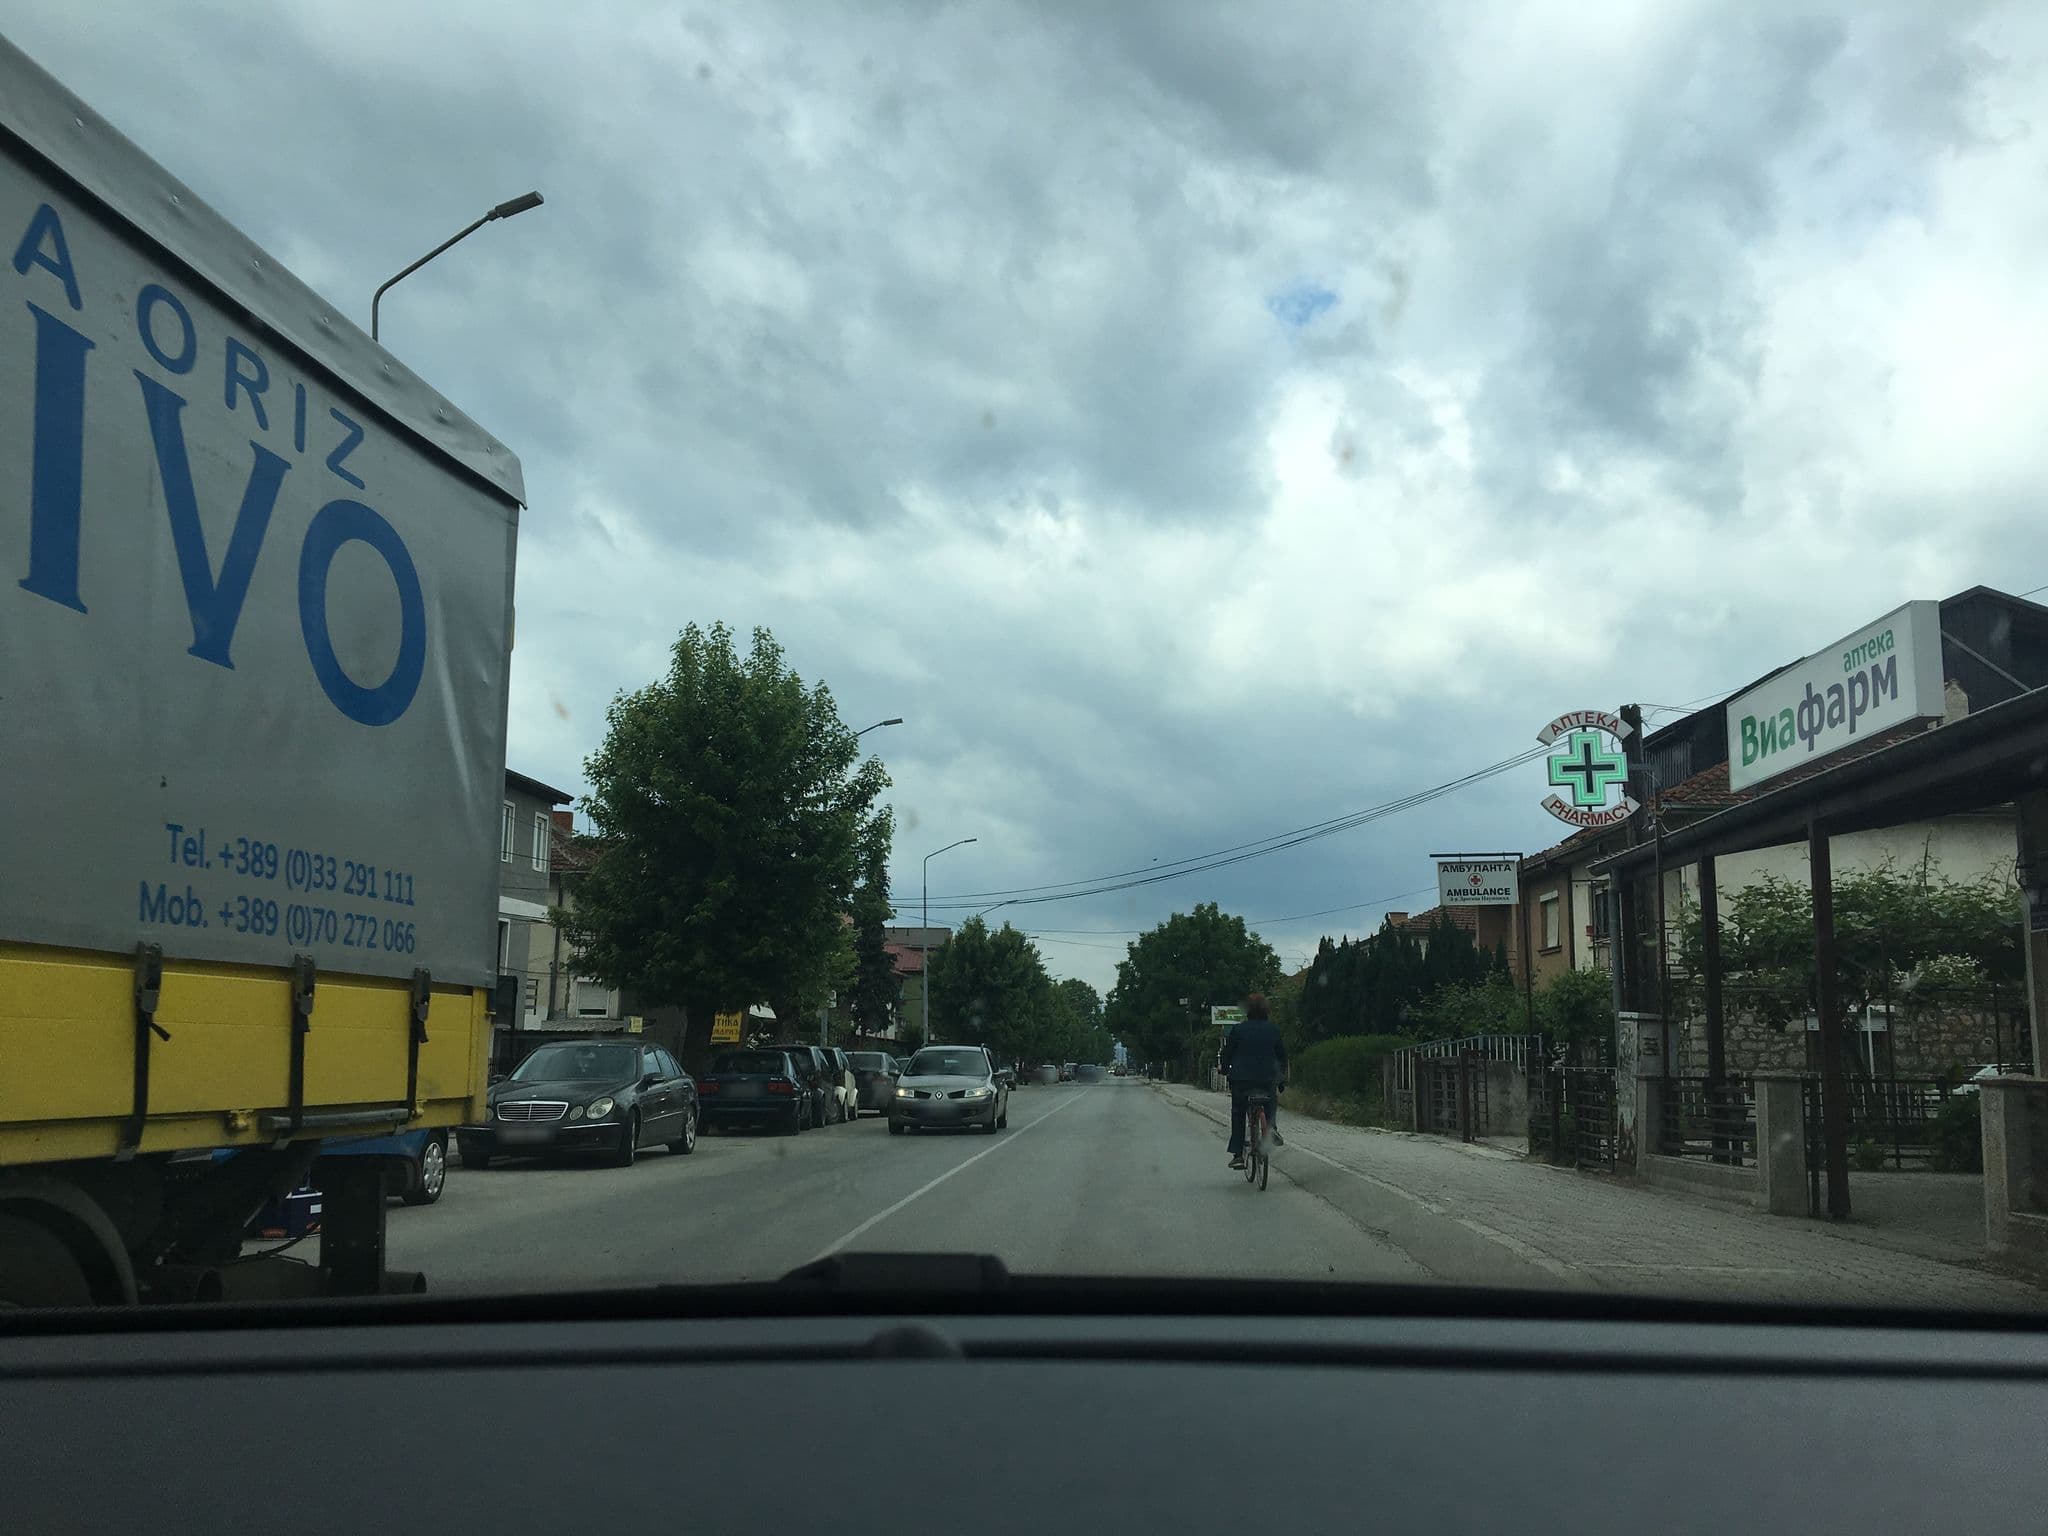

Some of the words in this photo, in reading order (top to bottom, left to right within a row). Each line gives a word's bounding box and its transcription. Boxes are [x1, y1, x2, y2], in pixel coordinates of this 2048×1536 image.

[18, 299, 427, 727] IVO
[1843, 628, 1895, 672] аптека
[1550, 711, 1620, 736] АПТЕКА
[1740, 654, 1899, 768] Виафарм
[1549, 799, 1632, 825] PHARMACY
[165, 823, 210, 869] Tel.
[218, 837, 279, 880] +389
[285, 848, 337, 892] (0)33
[343, 860, 378, 899] 291
[383, 870, 415, 906] 111
[1442, 864, 1512, 873] АМБУЛАНТА
[1446, 887, 1511, 896] AMBULANCE
[139, 880, 208, 928] Mob.
[218, 895, 279, 937] +389
[285, 903, 337, 947] (0)70
[343, 912, 378, 949] 272
[383, 919, 416, 954] 066
